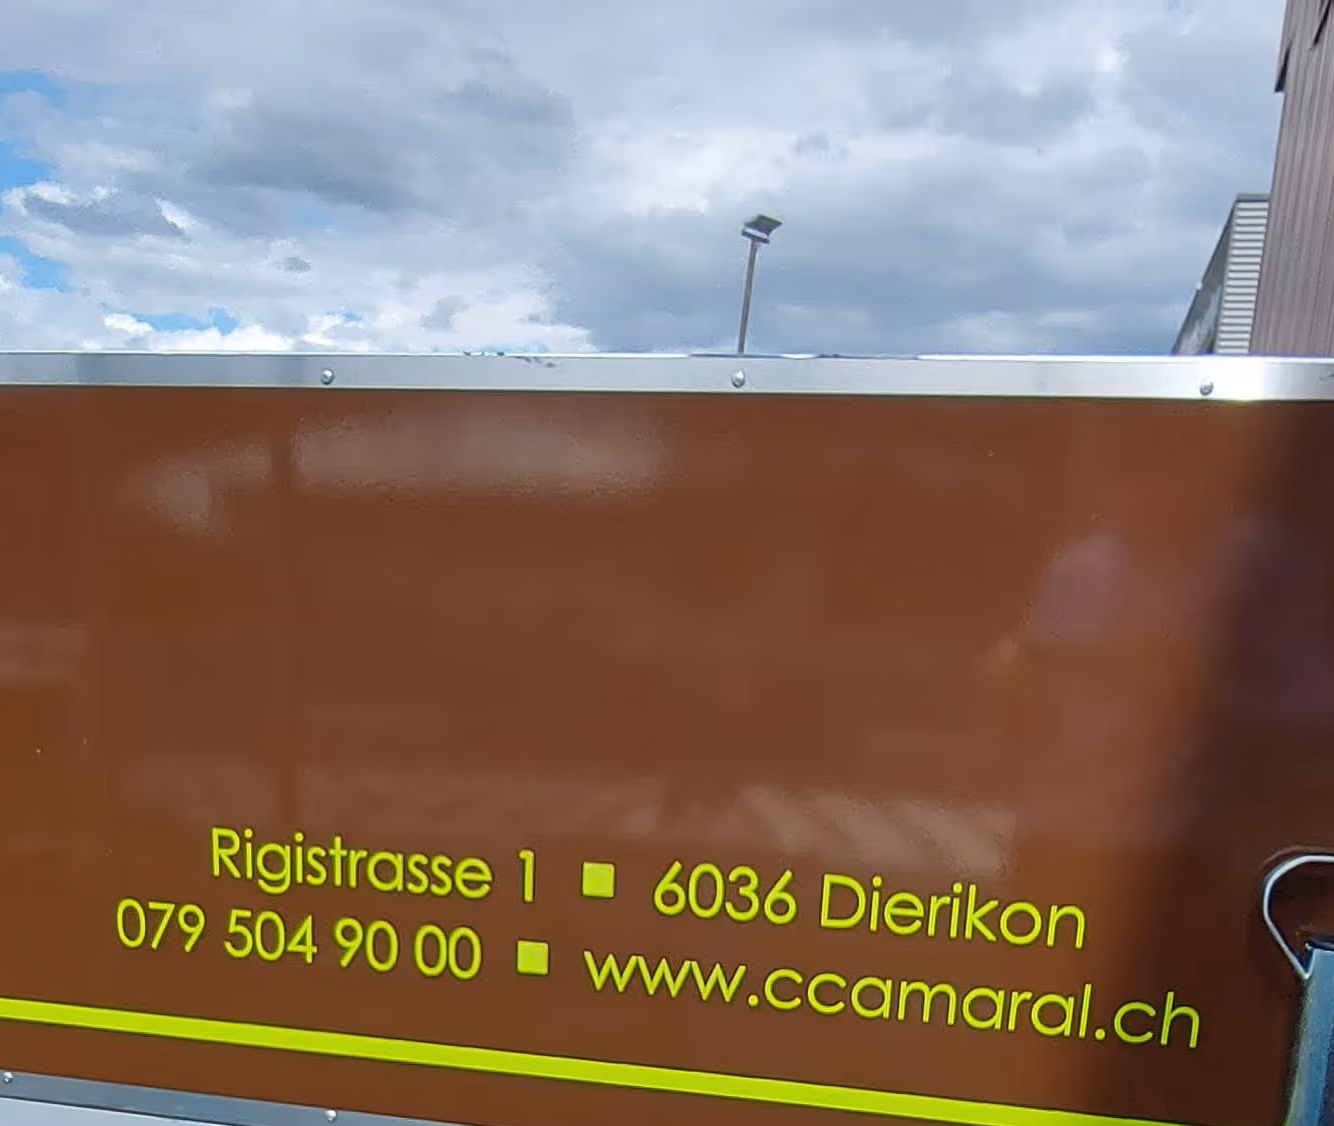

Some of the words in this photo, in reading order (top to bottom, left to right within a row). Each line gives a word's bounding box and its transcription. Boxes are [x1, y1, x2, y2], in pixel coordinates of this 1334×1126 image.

[210, 826, 492, 896] Rigistrasse
[518, 850, 535, 902] 1
[653, 862, 798, 925] 6036
[820, 874, 1087, 950] Dierikon
[116, 898, 207, 953] 079
[223, 908, 318, 964] 504
[333, 917, 400, 972] 90
[413, 924, 482, 980] 00
[583, 951, 1202, 1050] www.ccamaral.ch
